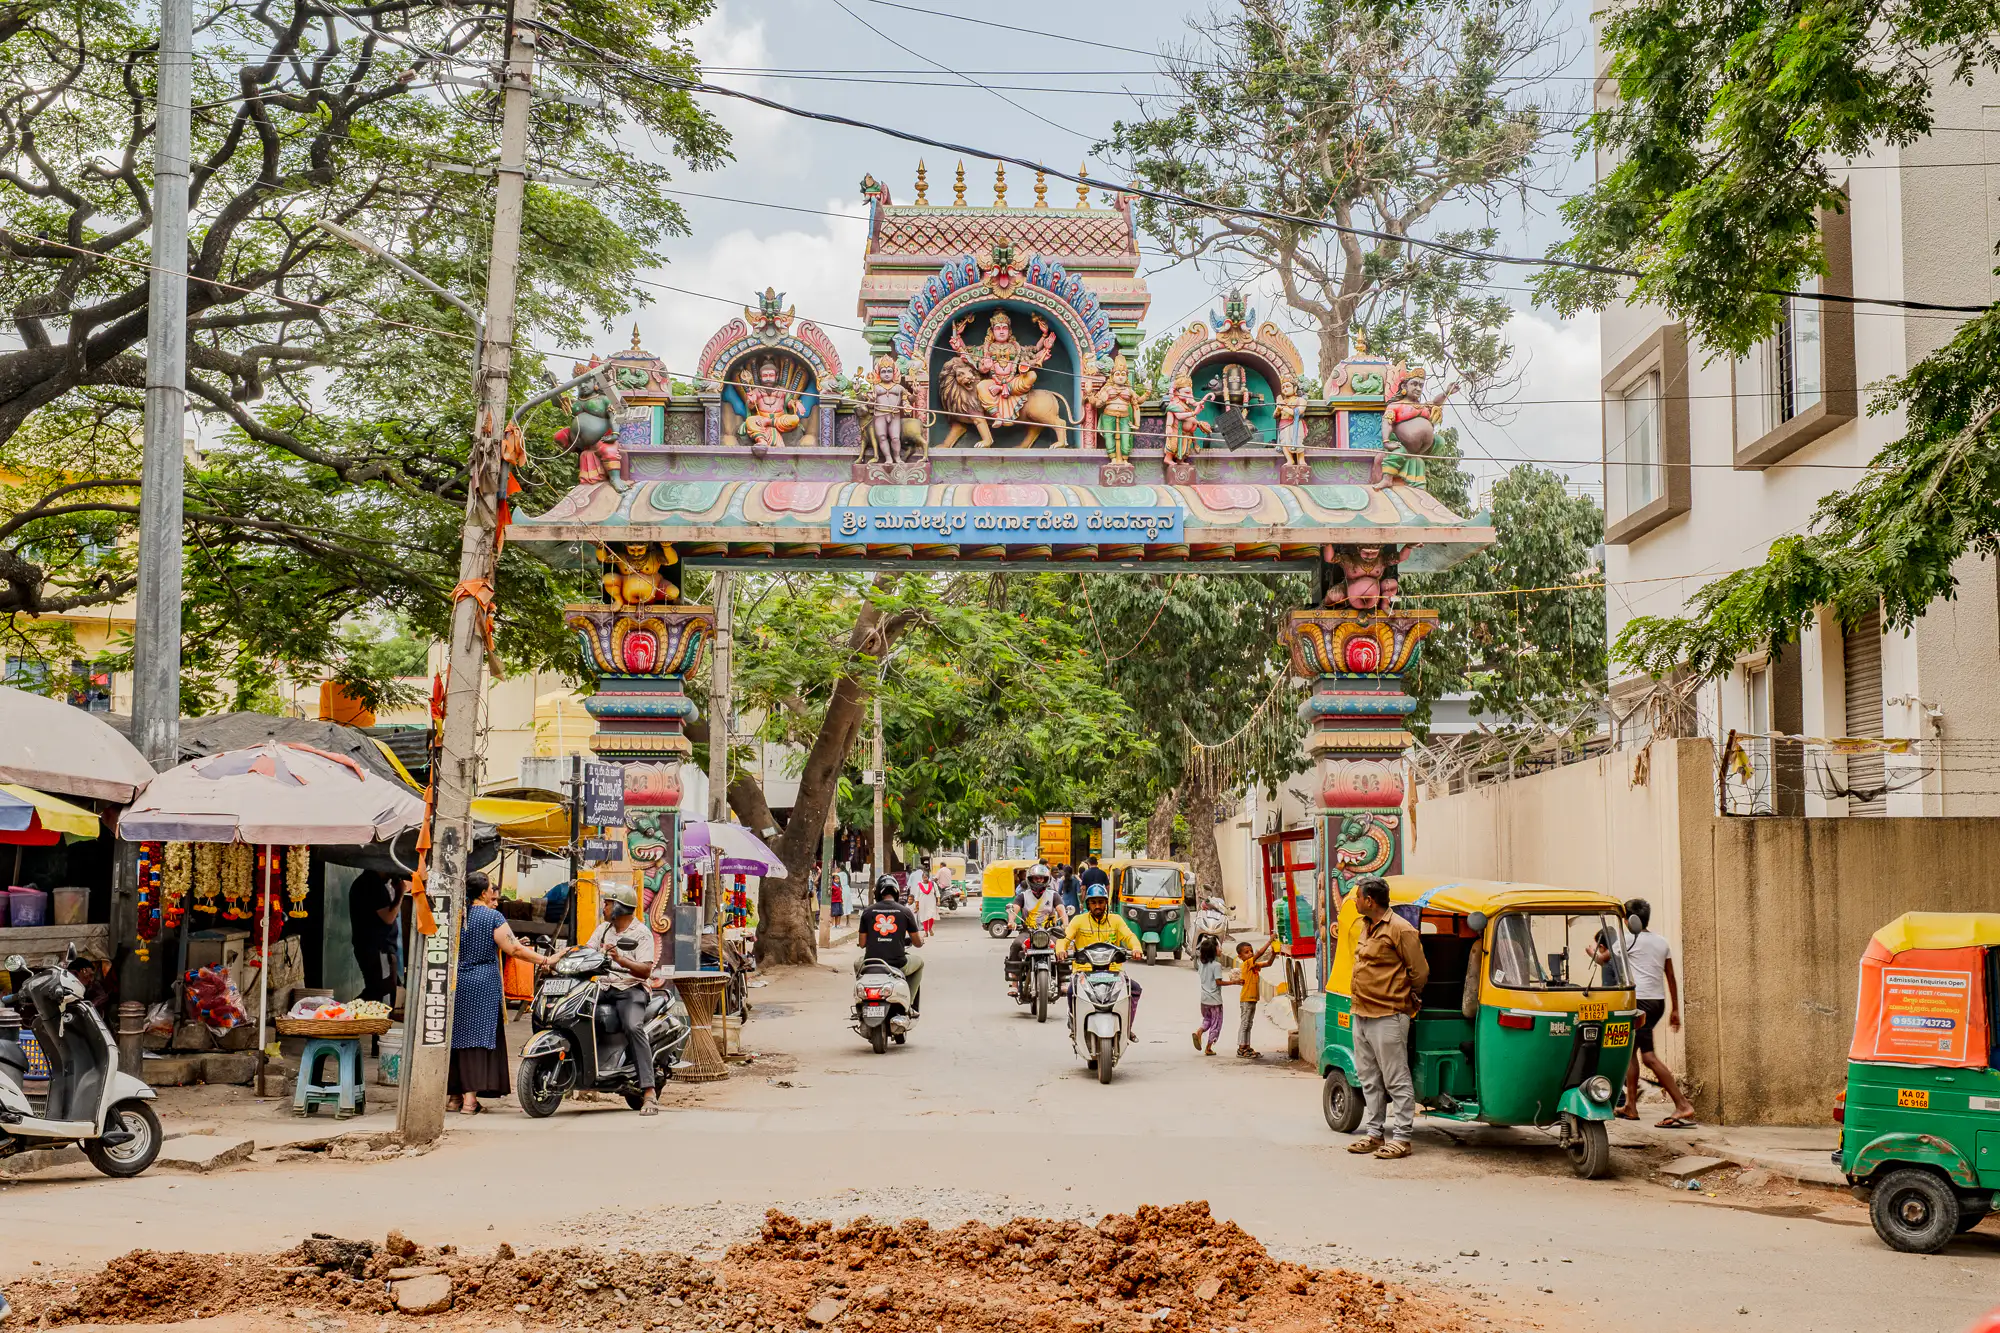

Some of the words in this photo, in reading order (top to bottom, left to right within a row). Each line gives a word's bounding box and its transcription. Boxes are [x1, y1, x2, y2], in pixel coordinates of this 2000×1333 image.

[840, 510, 867, 536] ಶ್ರೀ
[874, 509, 967, 535] ಮುನೇಶ್ವರ
[1086, 510, 1175, 540] ದೇವಸ್ಥಾನ
[425, 968, 447, 1043] CIRCUS
[1584, 1012, 1605, 1020] B1627
[1550, 1021, 1565, 1033] bajaj
[1900, 1017, 1951, 1028] 9513743732
[1606, 1023, 1629, 1034] KA02
[1610, 1035, 1628, 1046] 1627
[1902, 1090, 1913, 1098] KA
[1915, 1091, 1925, 1099] 02
